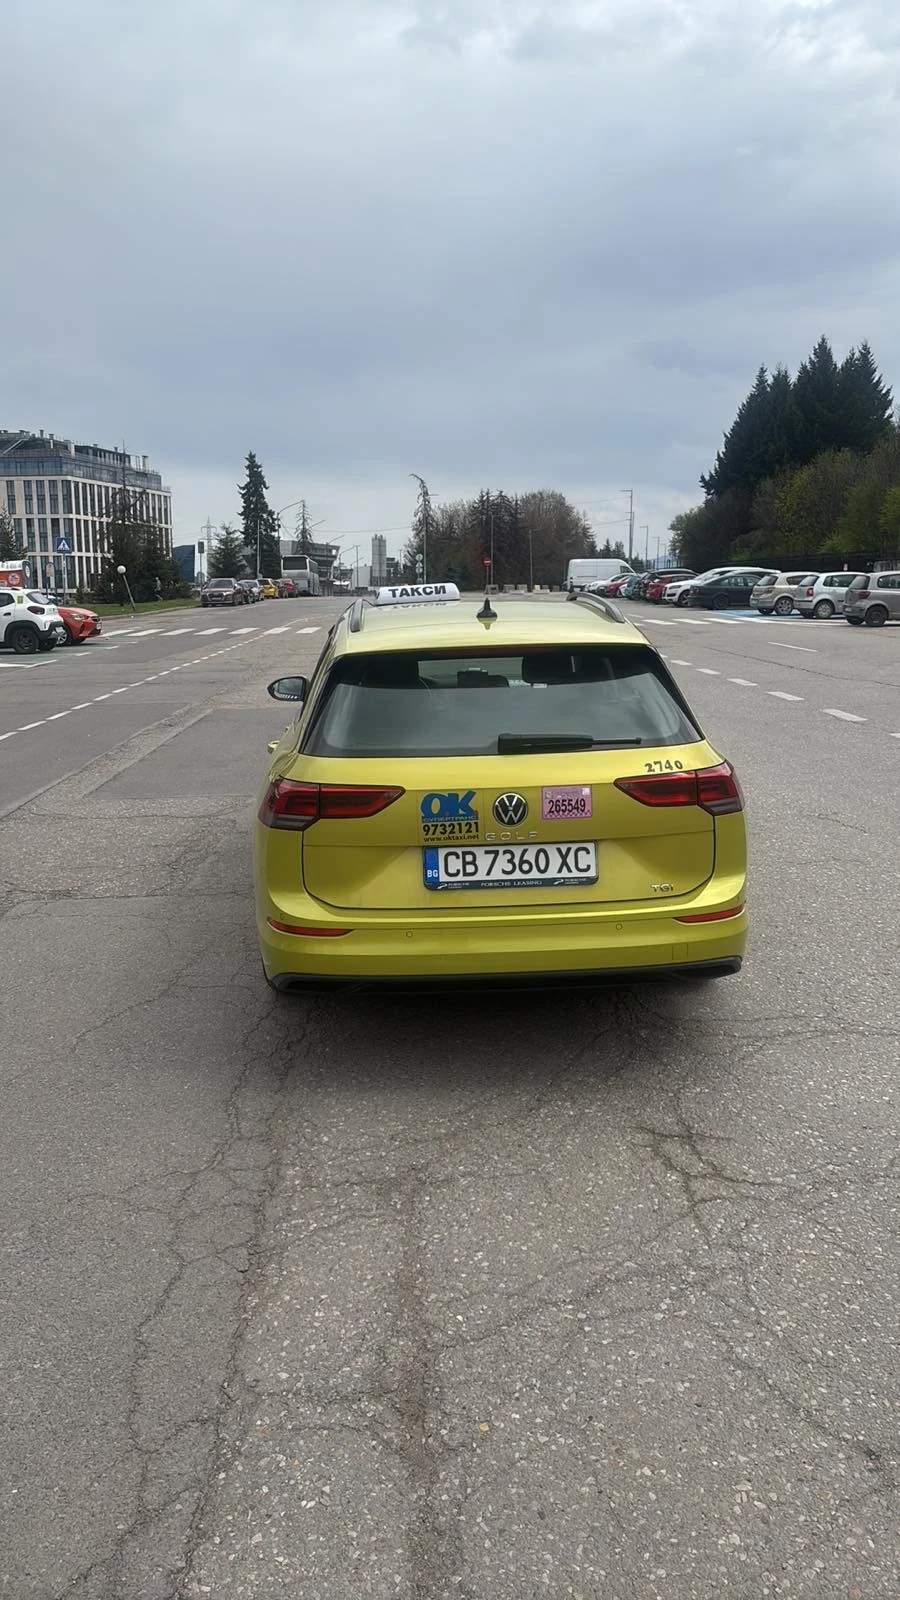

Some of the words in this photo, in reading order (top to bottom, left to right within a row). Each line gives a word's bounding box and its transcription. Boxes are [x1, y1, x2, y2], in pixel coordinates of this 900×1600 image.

[388, 585, 447, 598] ТАКСИ
[644, 760, 683, 772] 2740
[547, 798, 586, 814] 265549
[422, 821, 479, 836] 9732121
[423, 834, 480, 842] www.oktaxi.net
[485, 831, 538, 841] GOLF
[443, 850, 479, 878] CB
[484, 848, 550, 876] 7360
[556, 846, 591, 874] XC
[426, 869, 439, 878] BG
